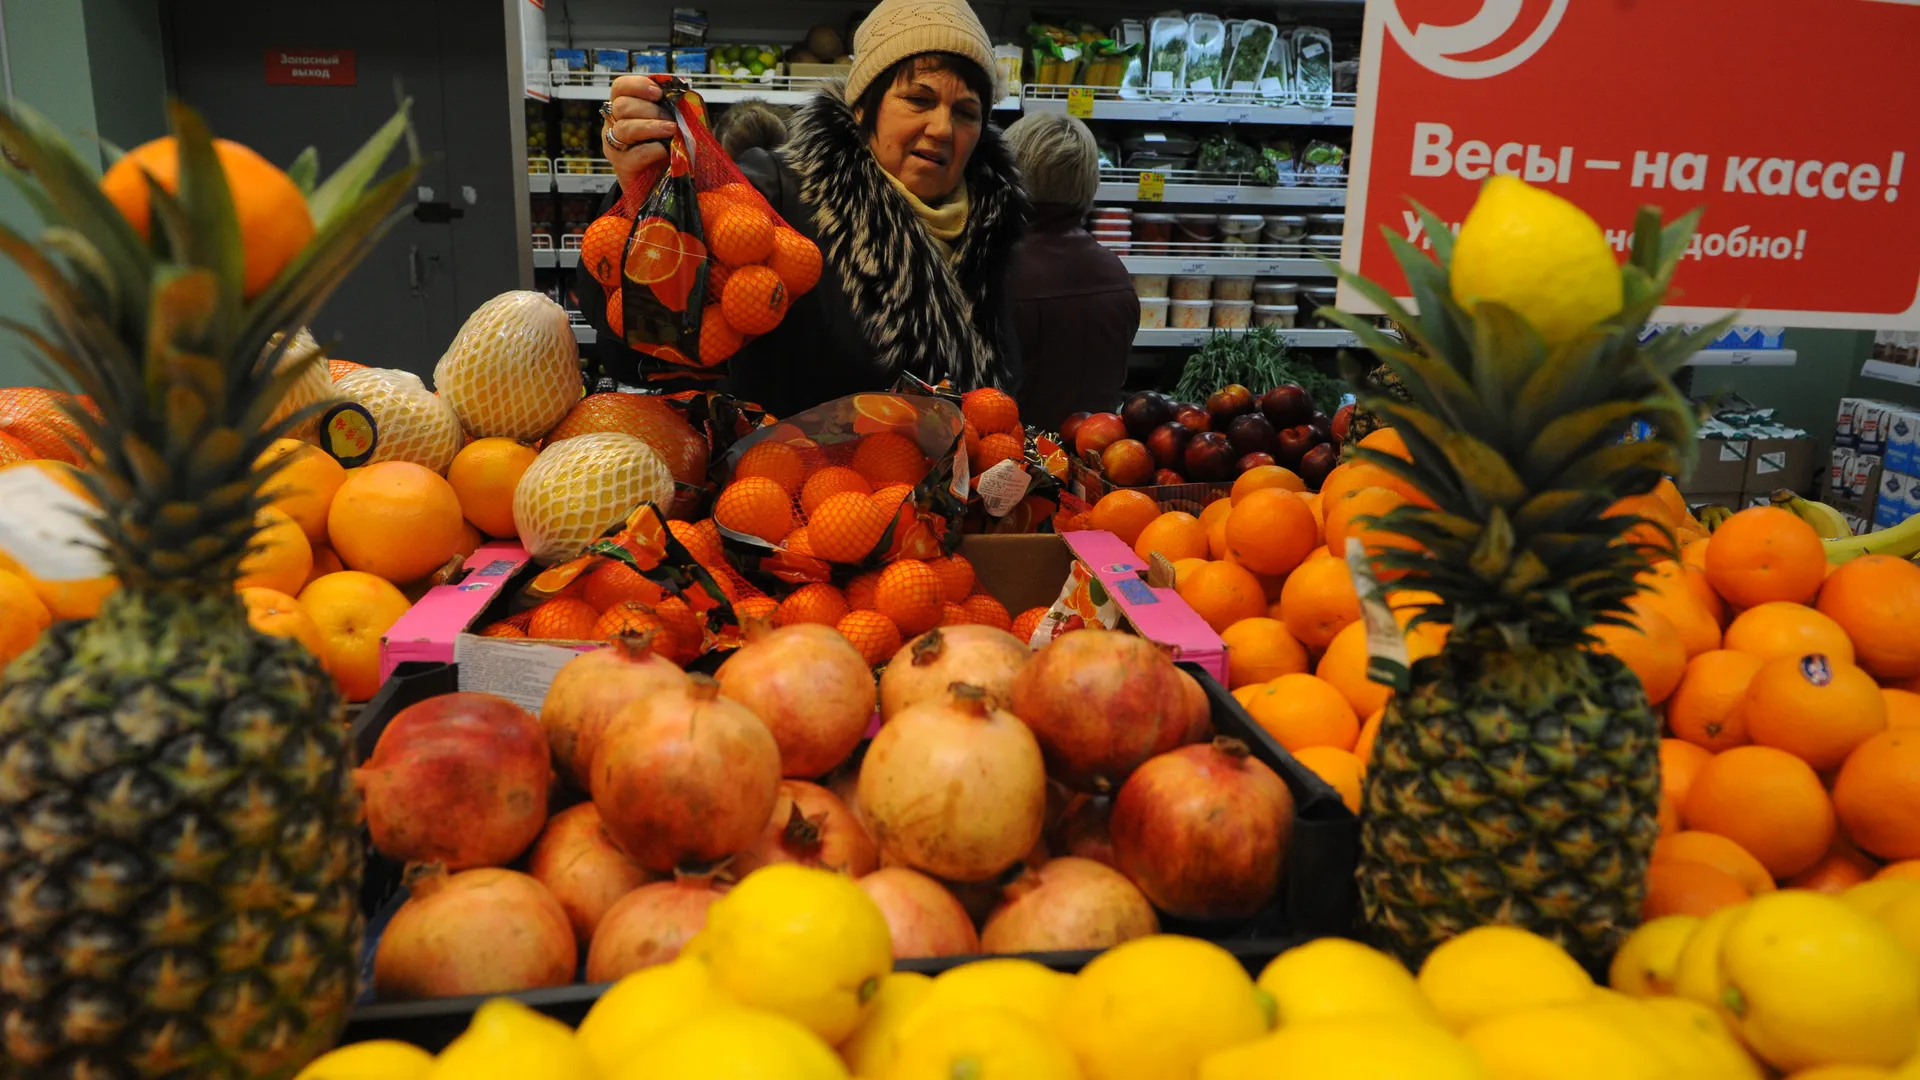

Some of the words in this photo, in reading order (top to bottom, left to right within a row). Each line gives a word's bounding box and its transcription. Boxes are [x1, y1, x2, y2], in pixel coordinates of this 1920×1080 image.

[280, 53, 340, 65] Запасный
[291, 68, 331, 79] выход
[1410, 122, 1573, 185] Весы
[1631, 150, 1708, 191] на
[1723, 151, 1906, 203] кассе!
[1672, 225, 1807, 261] добно!
